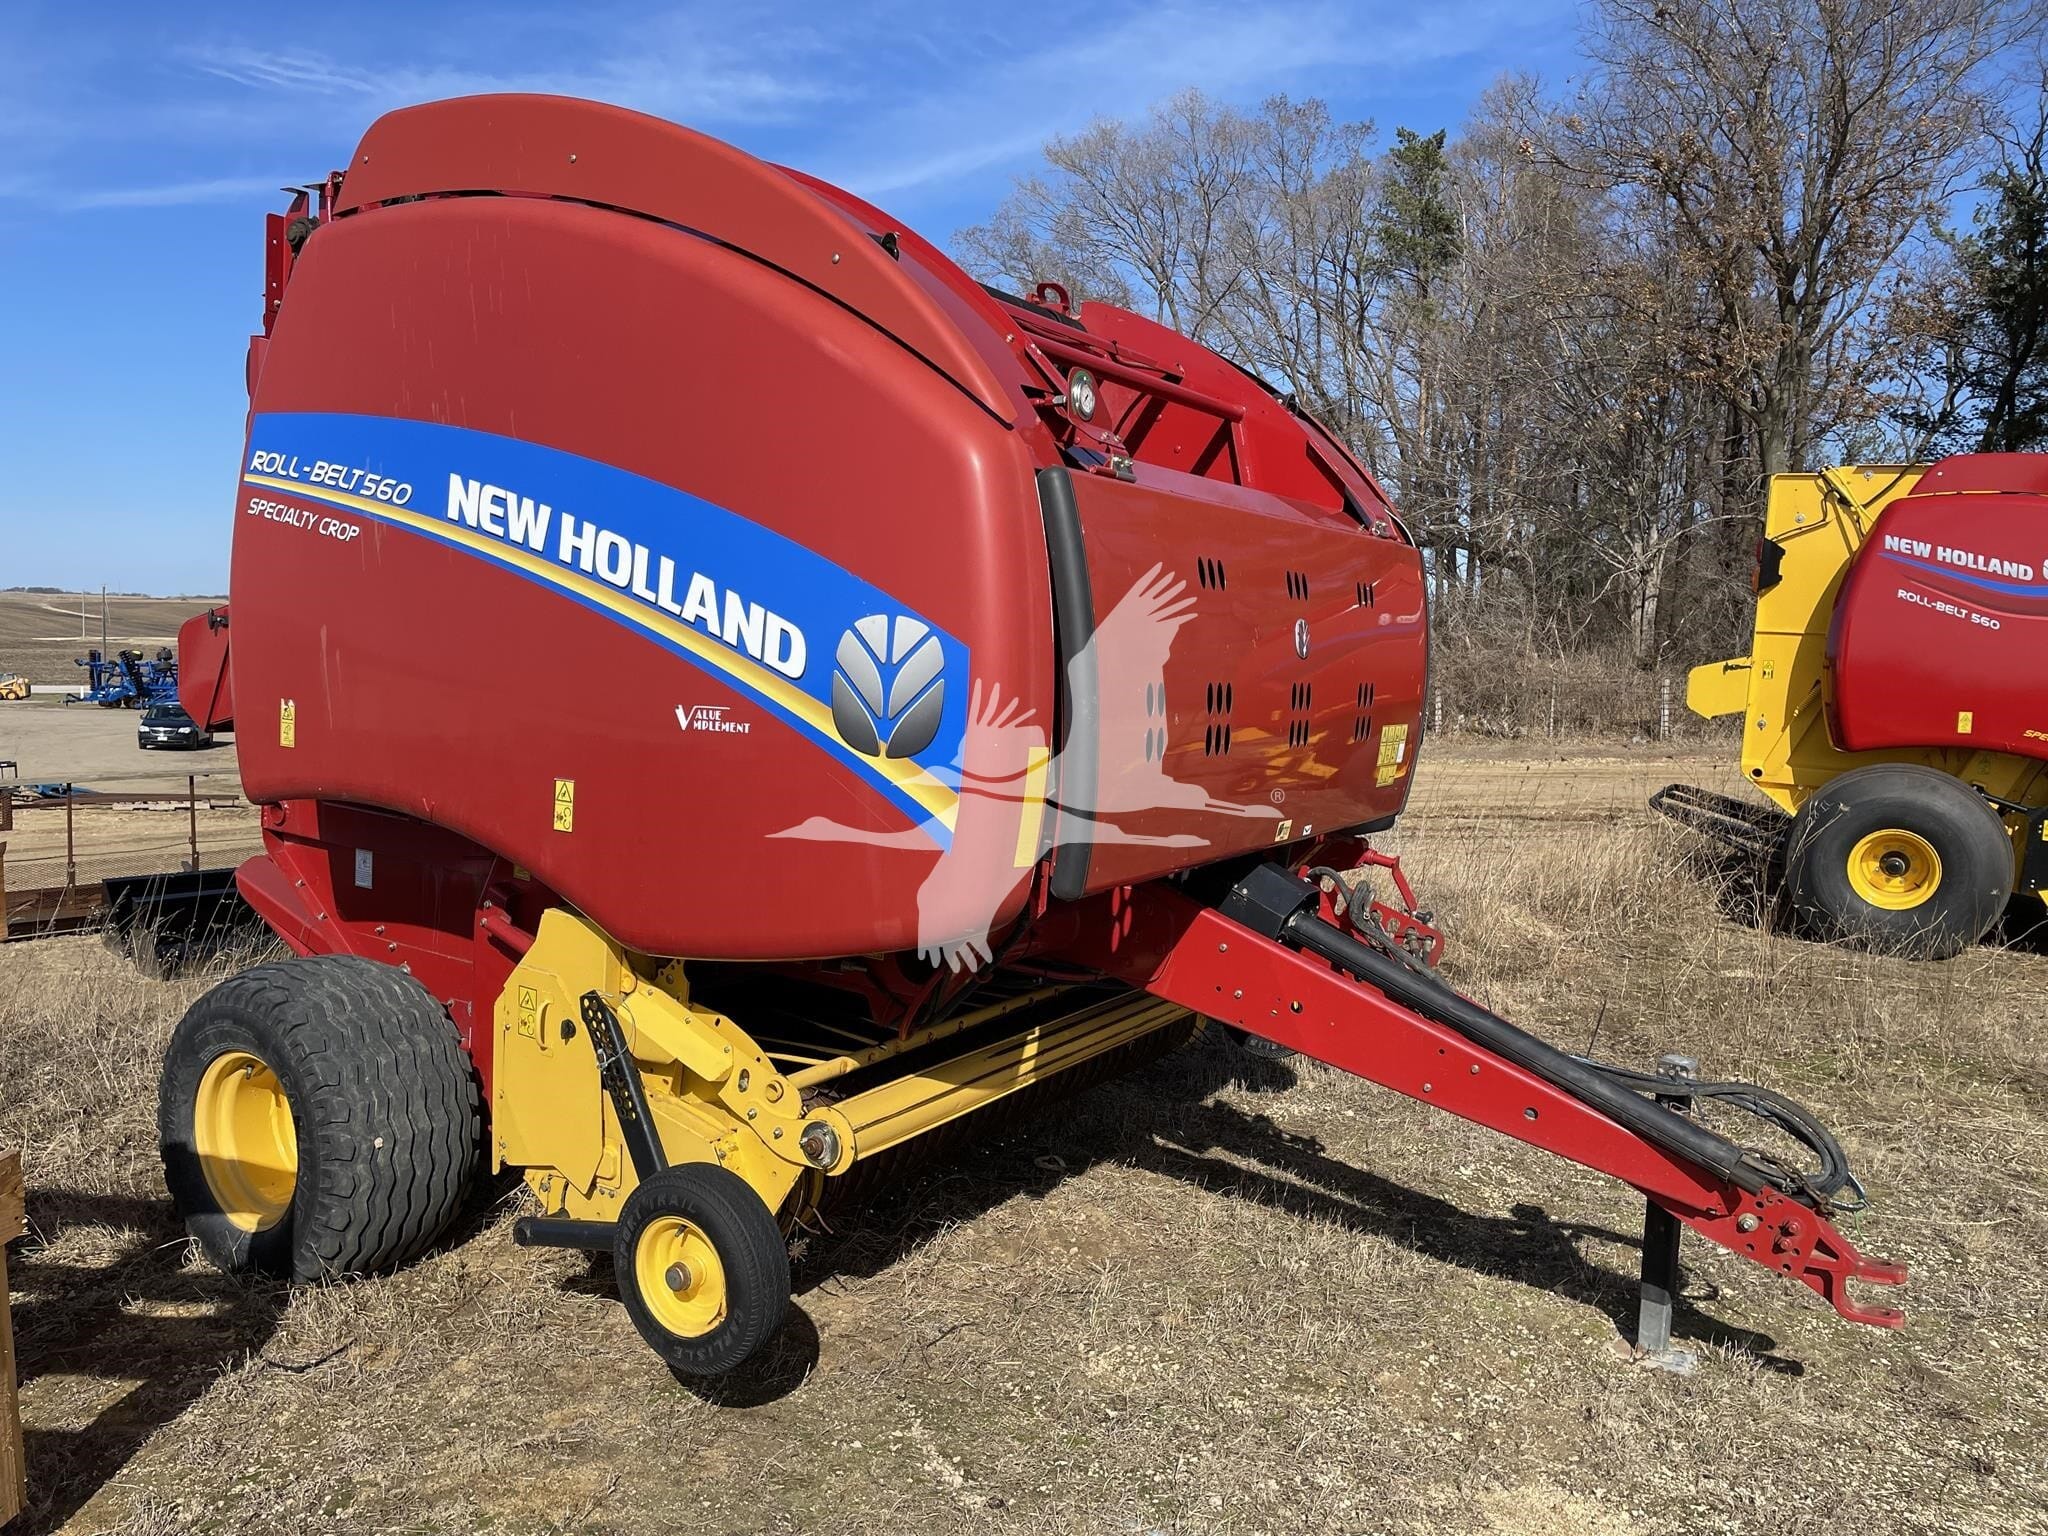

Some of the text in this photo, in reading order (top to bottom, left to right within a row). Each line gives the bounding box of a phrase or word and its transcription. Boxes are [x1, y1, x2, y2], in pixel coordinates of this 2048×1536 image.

[248, 498, 360, 542] SPECIALTY CROP
[447, 472, 807, 680] NEW HOLLAND
[1884, 534, 2034, 582] NEW HOLLAND
[1897, 589, 2001, 631] ROLL-BELT 560
